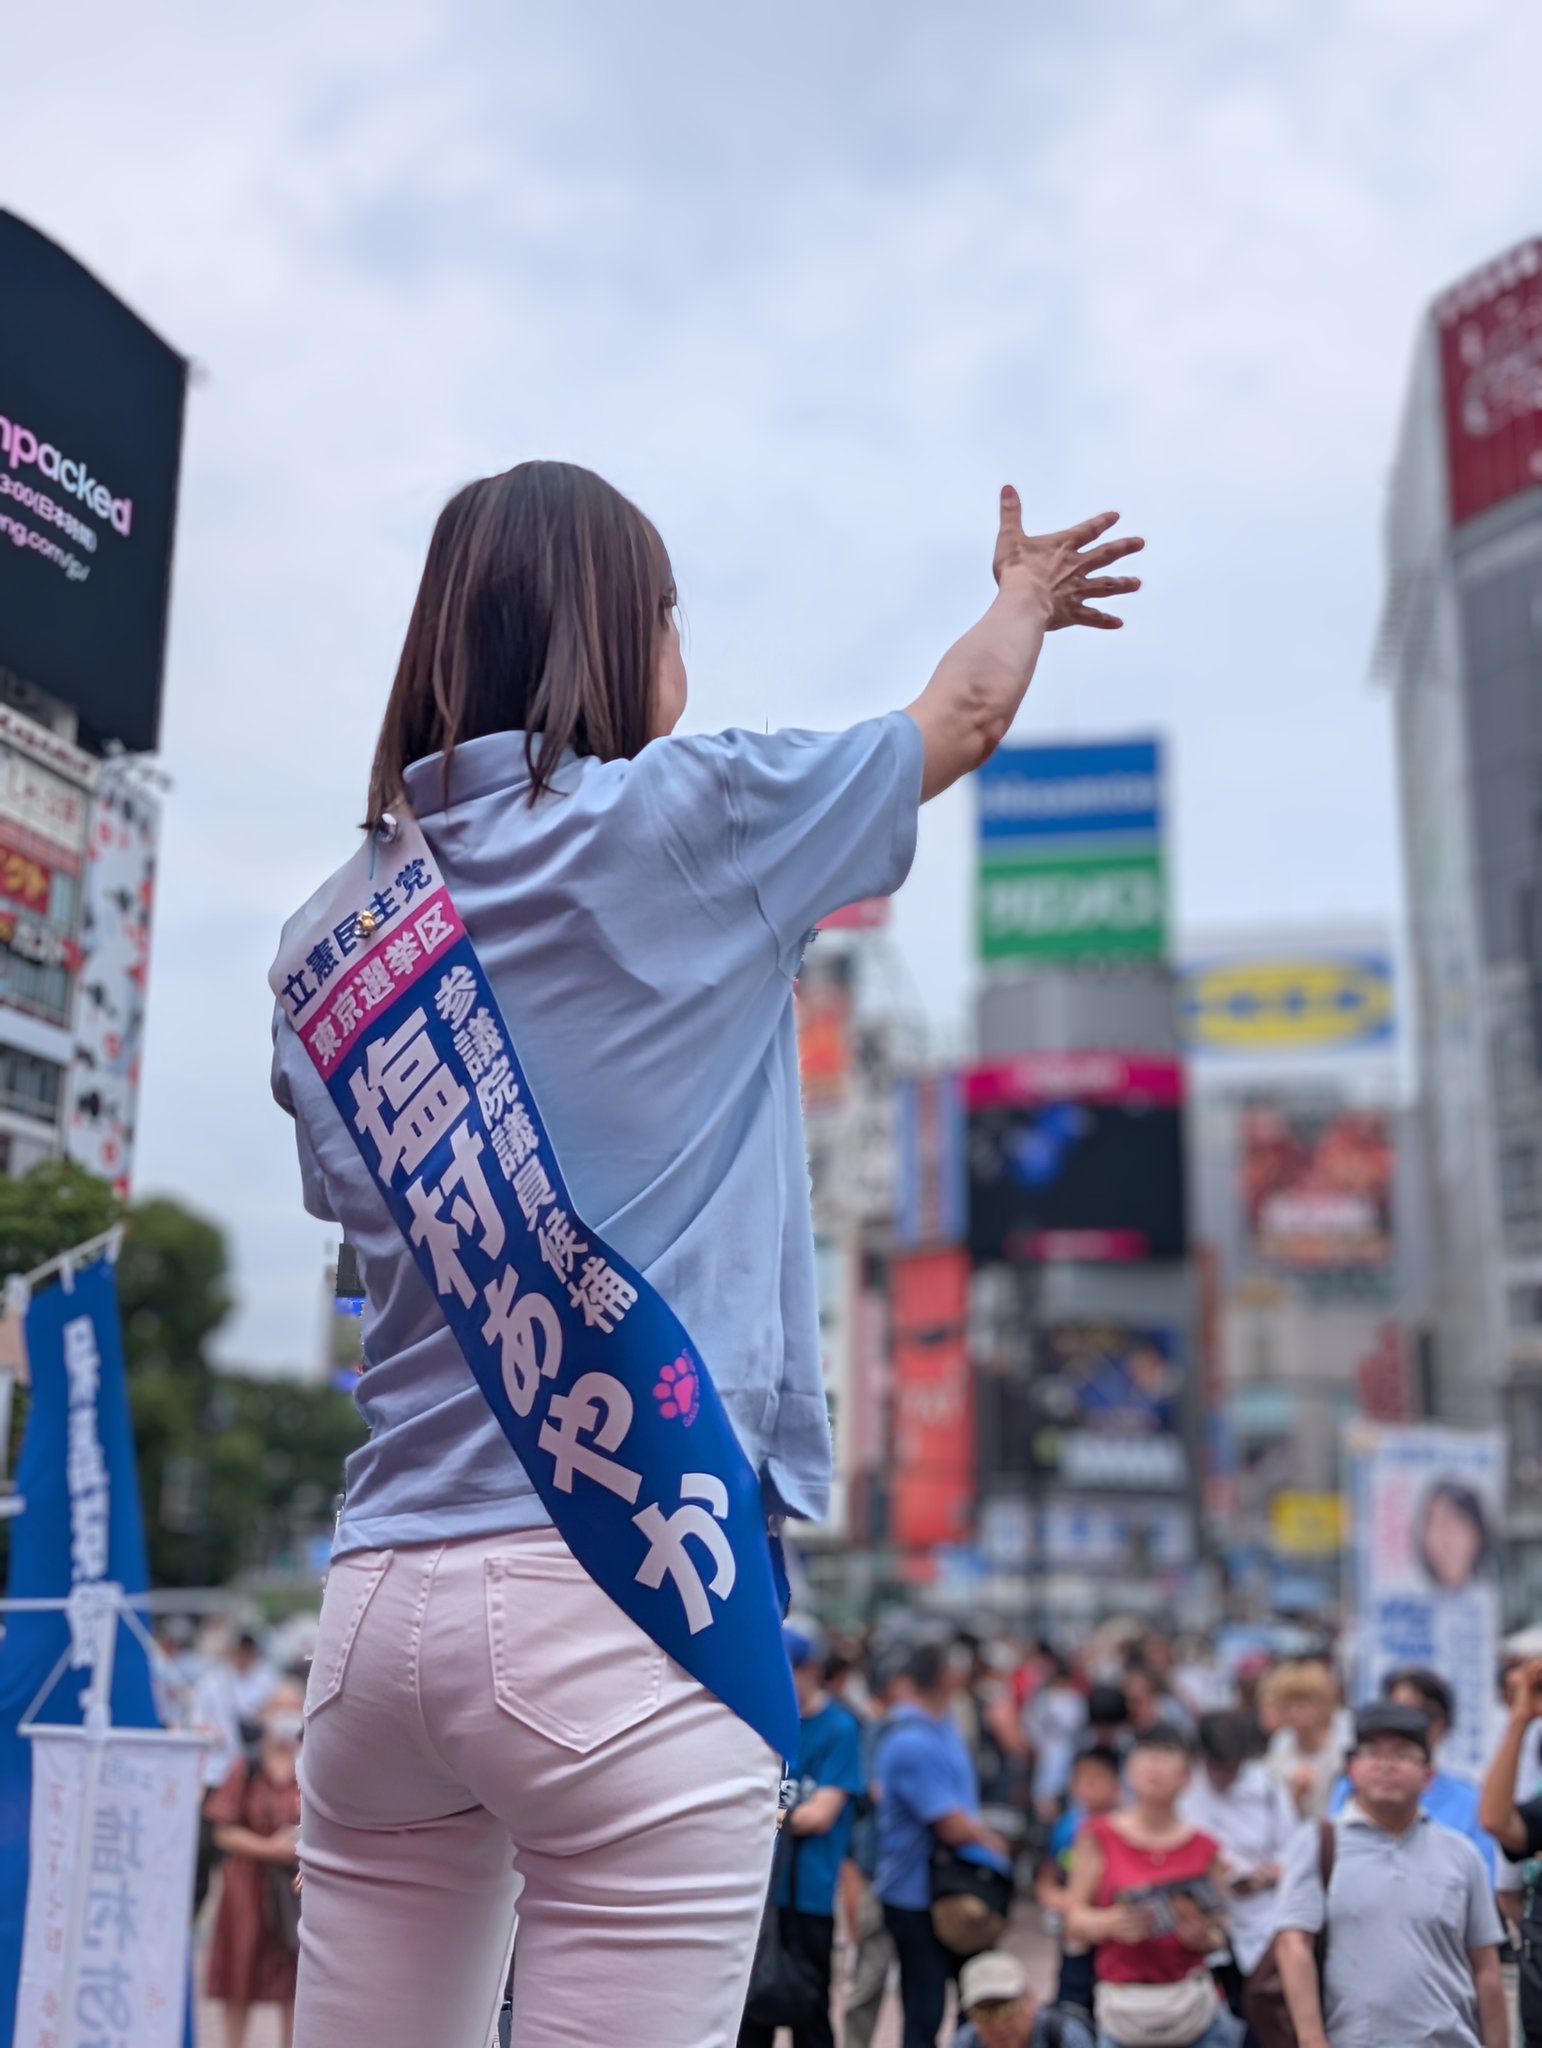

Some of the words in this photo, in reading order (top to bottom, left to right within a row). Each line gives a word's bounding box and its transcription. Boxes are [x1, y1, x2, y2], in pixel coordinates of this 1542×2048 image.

[281, 857, 433, 1017] 立憲民主党
[308, 900, 455, 1067] 東京選挙区
[433, 964, 639, 1335] 参議院議員候補
[346, 1006, 738, 1636] 塩村あやか
